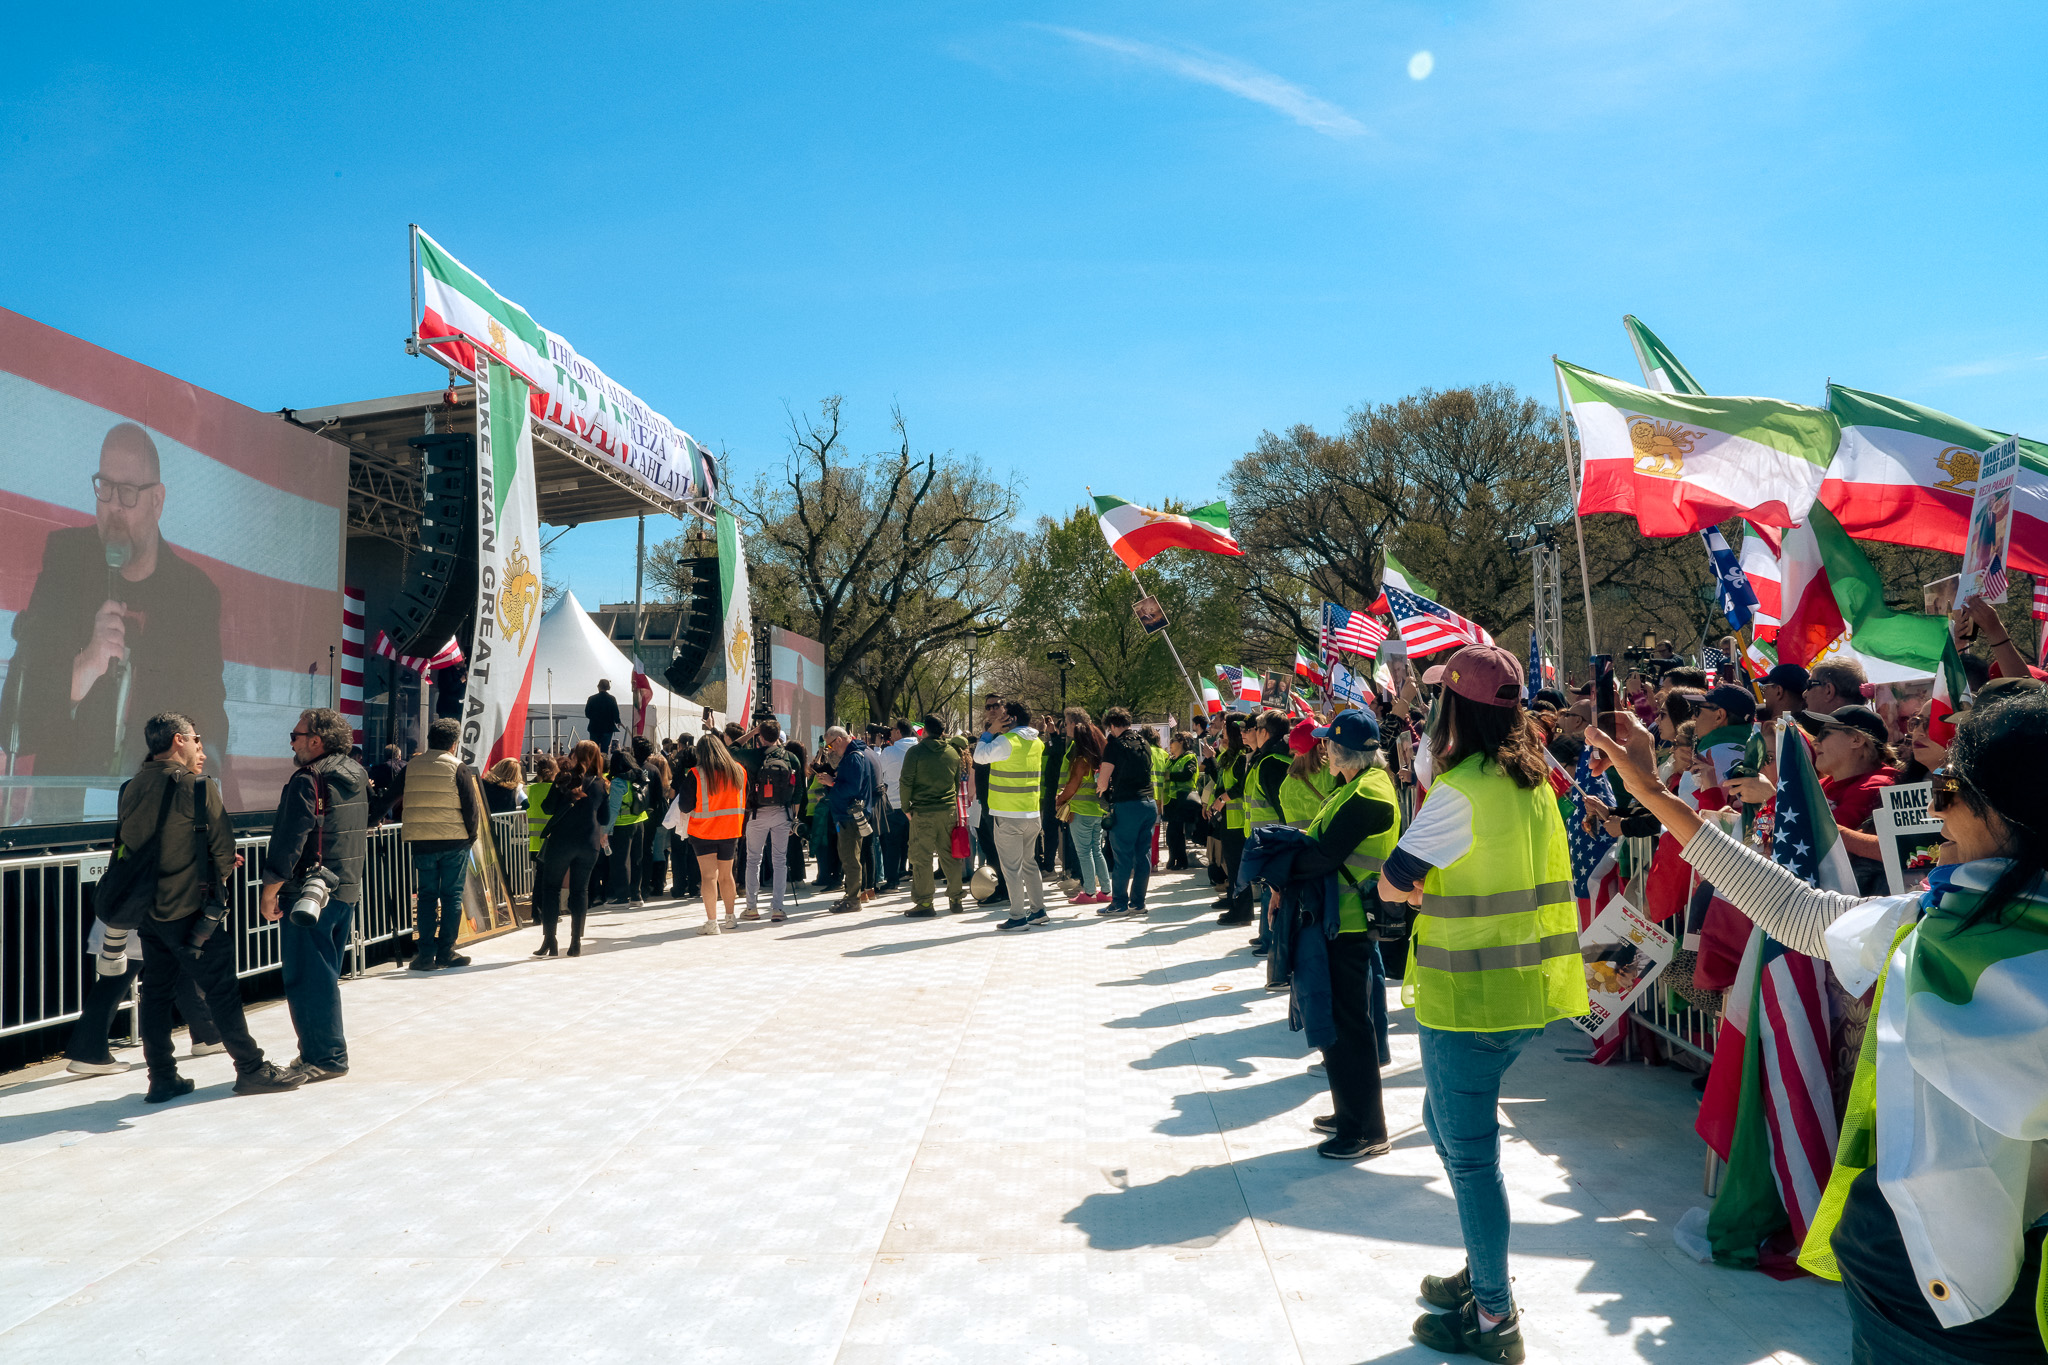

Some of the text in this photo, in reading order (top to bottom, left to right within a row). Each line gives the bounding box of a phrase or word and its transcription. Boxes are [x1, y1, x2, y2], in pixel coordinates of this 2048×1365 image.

[549, 339, 573, 374] THE
[573, 360, 606, 394] ONLY
[548, 362, 630, 465] IRAN
[630, 417, 667, 462] REZA
[1981, 454, 2016, 480] GREAT AGAIN
[1983, 439, 2016, 468] MAKE IRAN
[461, 353, 496, 766] MAKE IRAN GREAT AGA
[1889, 788, 1929, 811] MAKE
[1893, 808, 1930, 828] GREAT
[1573, 1011, 1599, 1033] MA
[1589, 999, 1611, 1019] REZA
